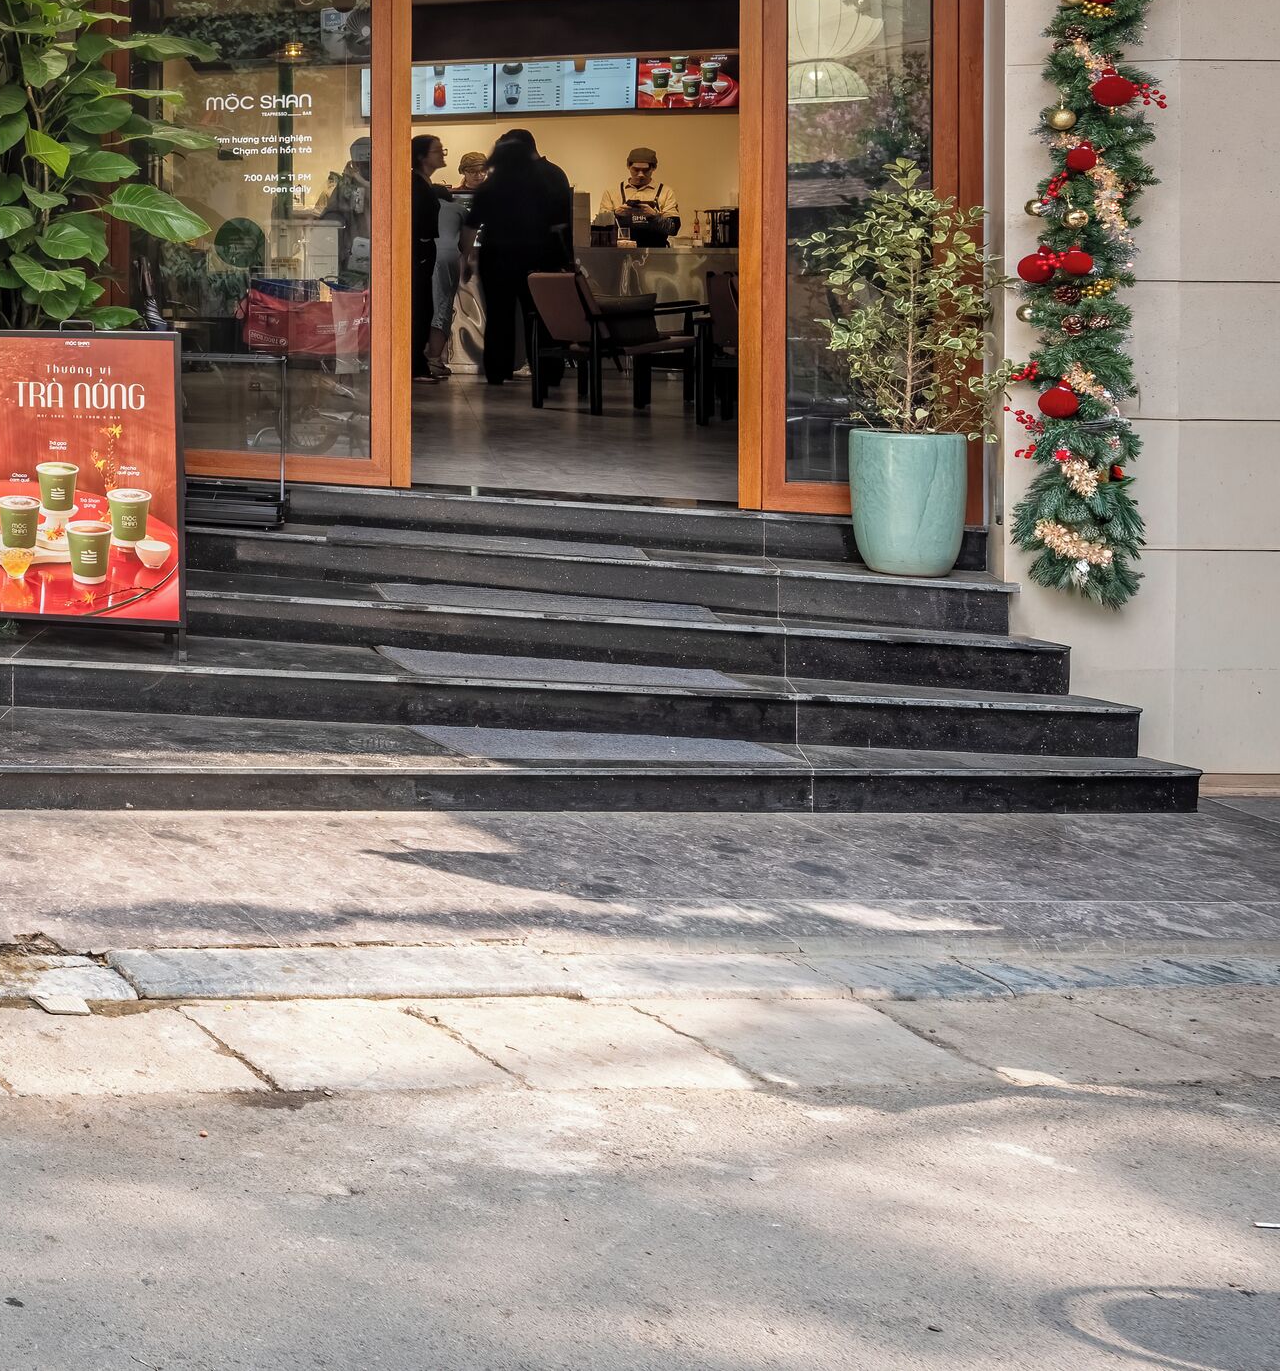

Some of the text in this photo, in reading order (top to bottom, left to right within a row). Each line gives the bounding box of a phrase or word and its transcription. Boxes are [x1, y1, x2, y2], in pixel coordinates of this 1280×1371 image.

[205, 93, 313, 113] MỘC SHAN
[232, 136, 260, 145] hương
[279, 134, 312, 144] nghiệm
[232, 147, 259, 157] Chạm
[244, 174, 263, 182] 7:00
[264, 174, 279, 182] AM
[297, 173, 312, 181] PM
[263, 184, 312, 194] Open daily
[46, 364, 111, 378] Thưởng vị
[13, 378, 145, 410] TRÀ NÓNG
